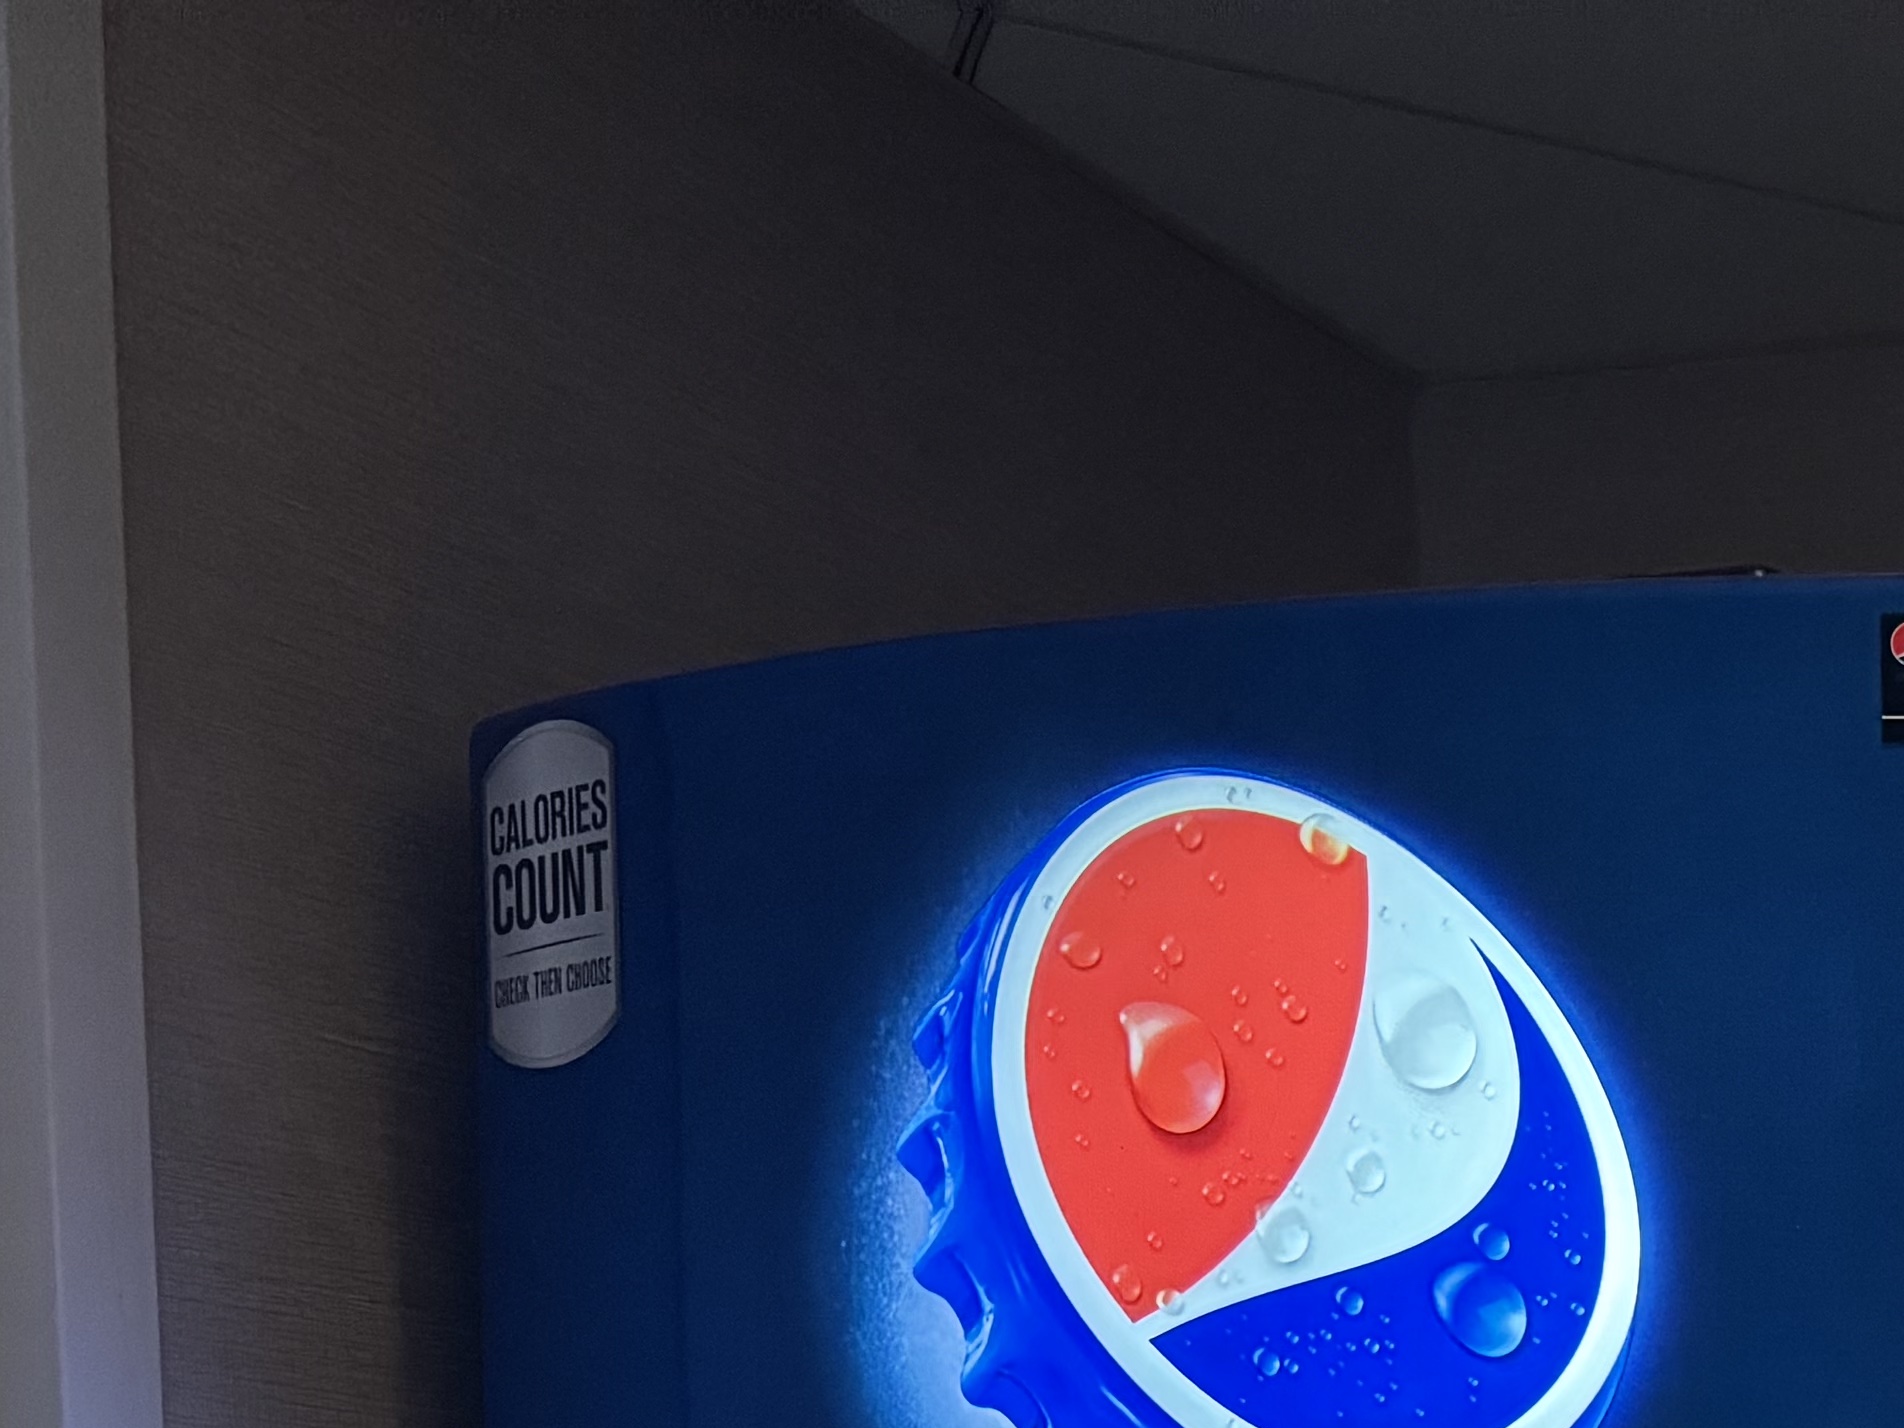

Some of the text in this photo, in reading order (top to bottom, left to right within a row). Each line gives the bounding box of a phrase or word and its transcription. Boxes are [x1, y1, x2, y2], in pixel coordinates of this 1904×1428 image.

[489, 779, 607, 857] CALORIES
[492, 840, 608, 935] COUNT
[494, 956, 612, 1009] CHECK THEN CHOOSE
